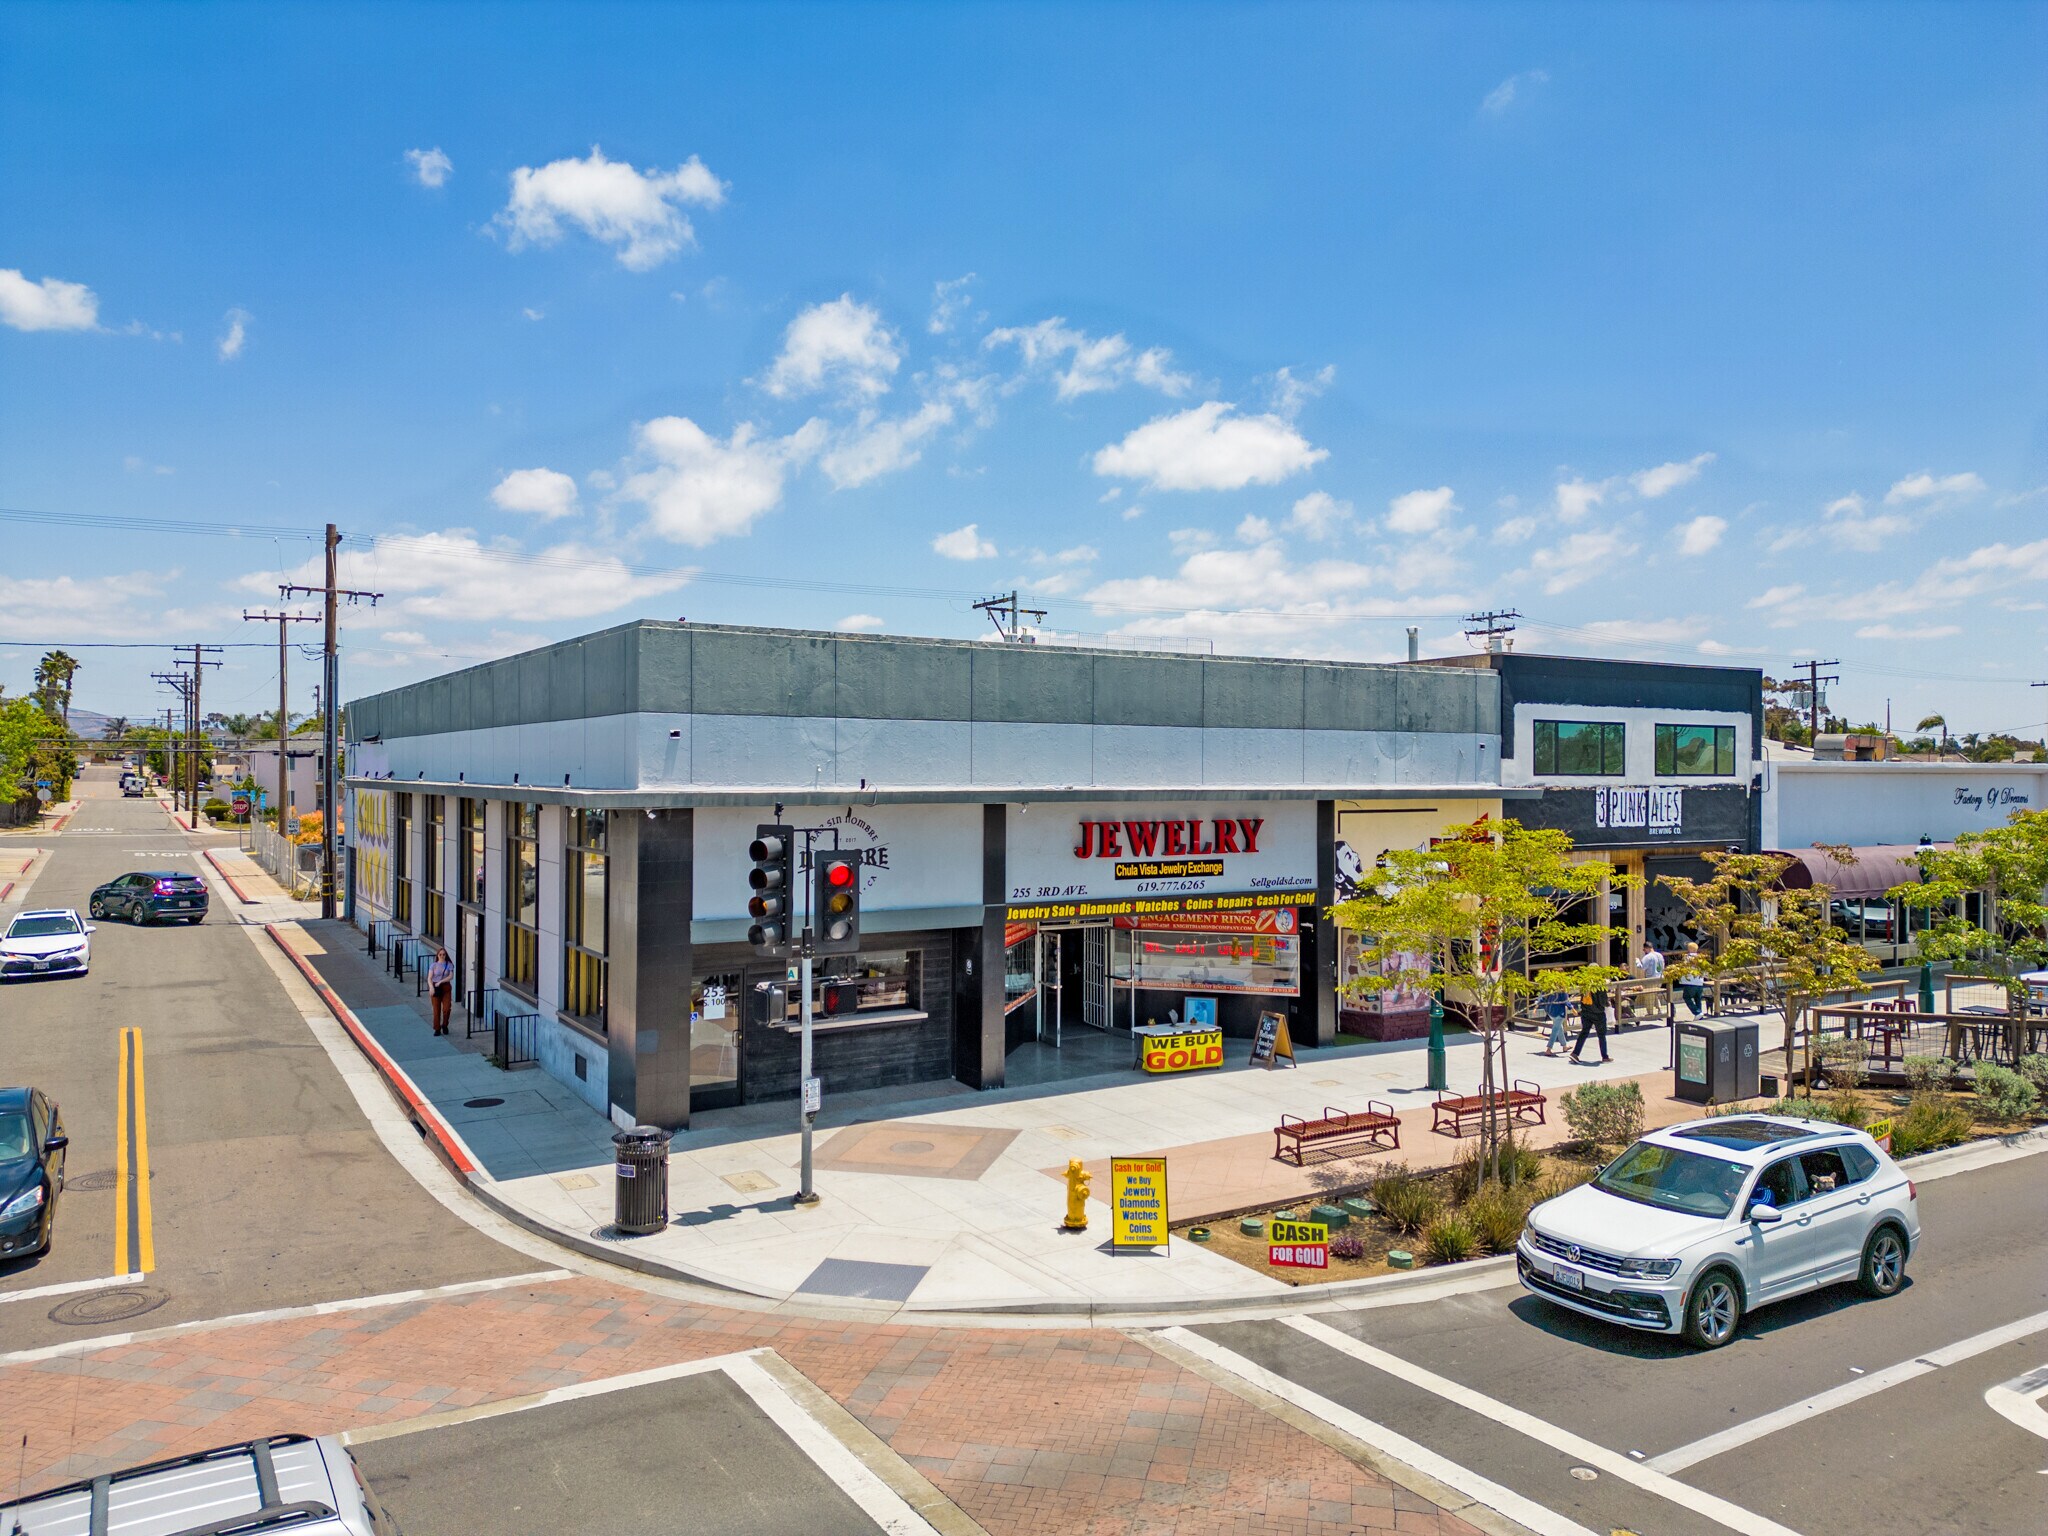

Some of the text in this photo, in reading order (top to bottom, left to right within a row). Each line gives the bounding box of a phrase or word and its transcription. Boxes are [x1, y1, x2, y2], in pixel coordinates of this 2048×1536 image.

[1953, 787, 2029, 812] Factory Of Dreams
[232, 803, 247, 811] STOP
[1598, 790, 1680, 824] 3 PUNK ALES
[1649, 827, 1672, 835] BREWING
[1073, 818, 1264, 859] JEWELRY
[1116, 861, 1223, 877] Chula Vista Jewelry Exchange
[1137, 880, 1205, 893] 619.777.6265
[1250, 876, 1313, 888] Sellgoldsd.com
[1012, 884, 1088, 899] 255 3RD AVE.
[1007, 892, 1316, 920] Jewelry Sale Diamonds Watches Coins Repairs Cash For Gold
[1140, 913, 1257, 925] ENGAGEMENT RINGS
[704, 985, 726, 998] 253
[711, 998, 725, 1006] 100
[1151, 1033, 1220, 1049] WE BUY
[1146, 1046, 1223, 1069] GOLD
[1114, 1163, 1162, 1172] Cash for Gold
[1127, 1176, 1151, 1186] We Buy
[1123, 1187, 1156, 1197] Jewelry
[1119, 1198, 1160, 1209] Diamonds
[1122, 1210, 1158, 1221] Watches
[1129, 1223, 1152, 1234] Coins
[1272, 1222, 1324, 1242] CASH
[1272, 1247, 1325, 1266] FOR GOLD
